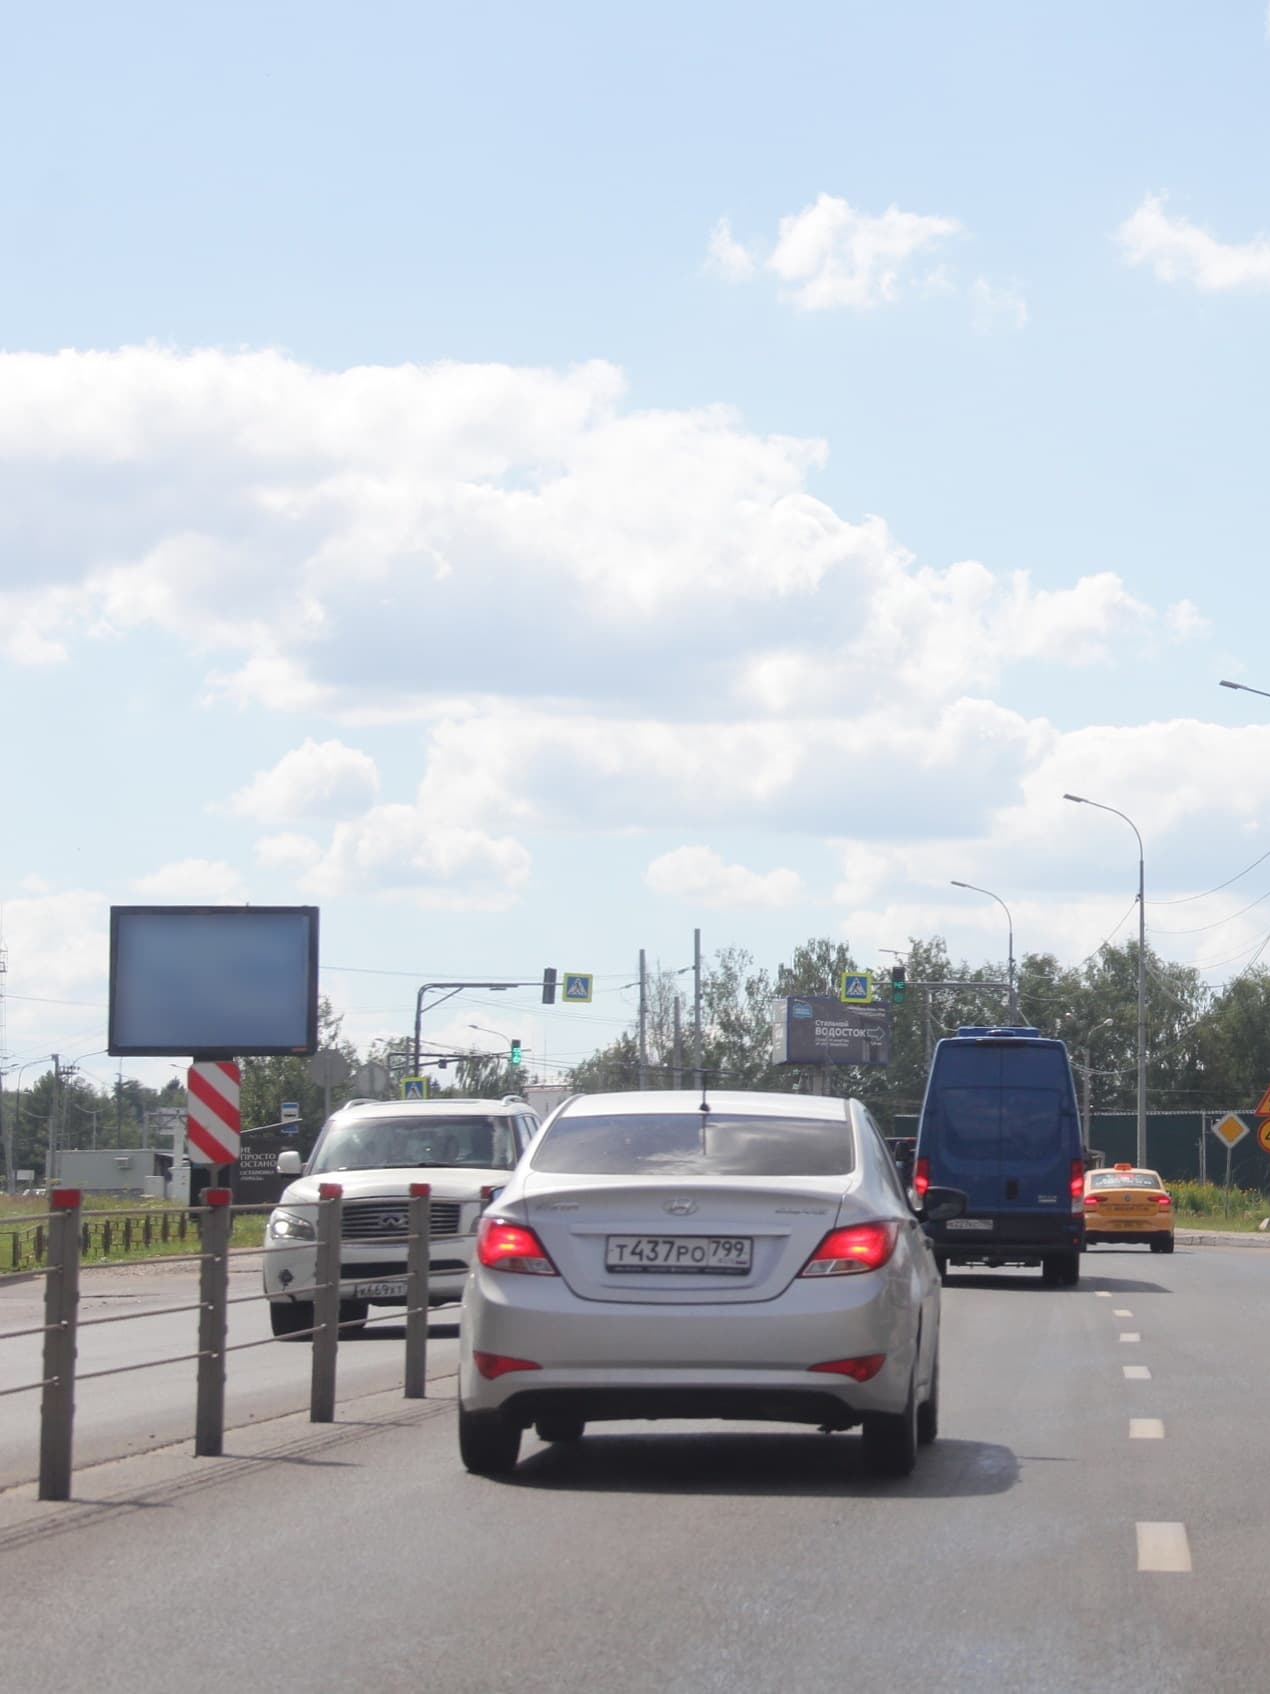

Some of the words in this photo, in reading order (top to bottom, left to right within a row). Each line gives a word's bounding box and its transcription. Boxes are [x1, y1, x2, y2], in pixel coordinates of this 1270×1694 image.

[815, 1027, 866, 1037] ВОДОСТОК
[240, 1160, 278, 1168] ОСТАНО
[616, 1240, 705, 1263] Т437РО
[712, 1241, 744, 1258] 799
